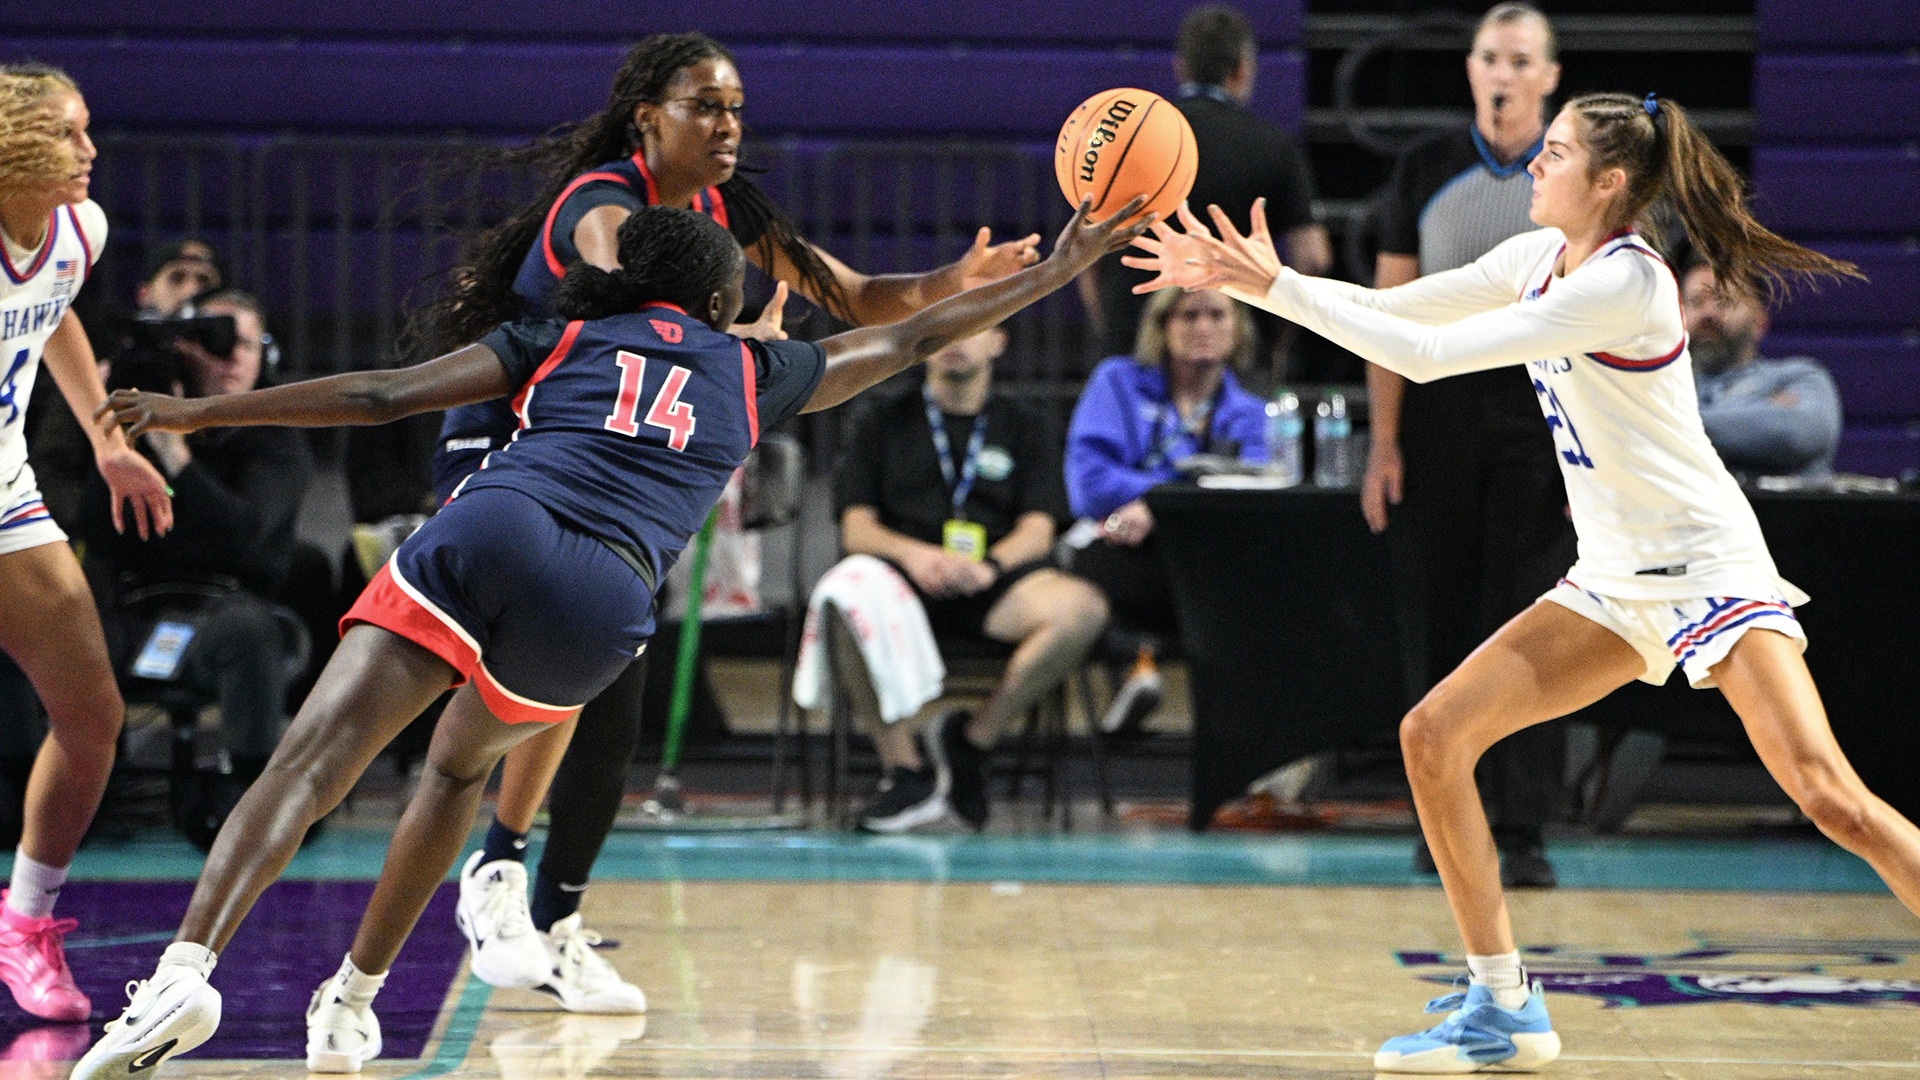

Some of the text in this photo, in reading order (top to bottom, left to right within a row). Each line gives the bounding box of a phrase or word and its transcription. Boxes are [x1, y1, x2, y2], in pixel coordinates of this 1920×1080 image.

[1080, 100, 1138, 182] Wilson
[2, 298, 71, 340] HAWK
[604, 350, 696, 452] 14
